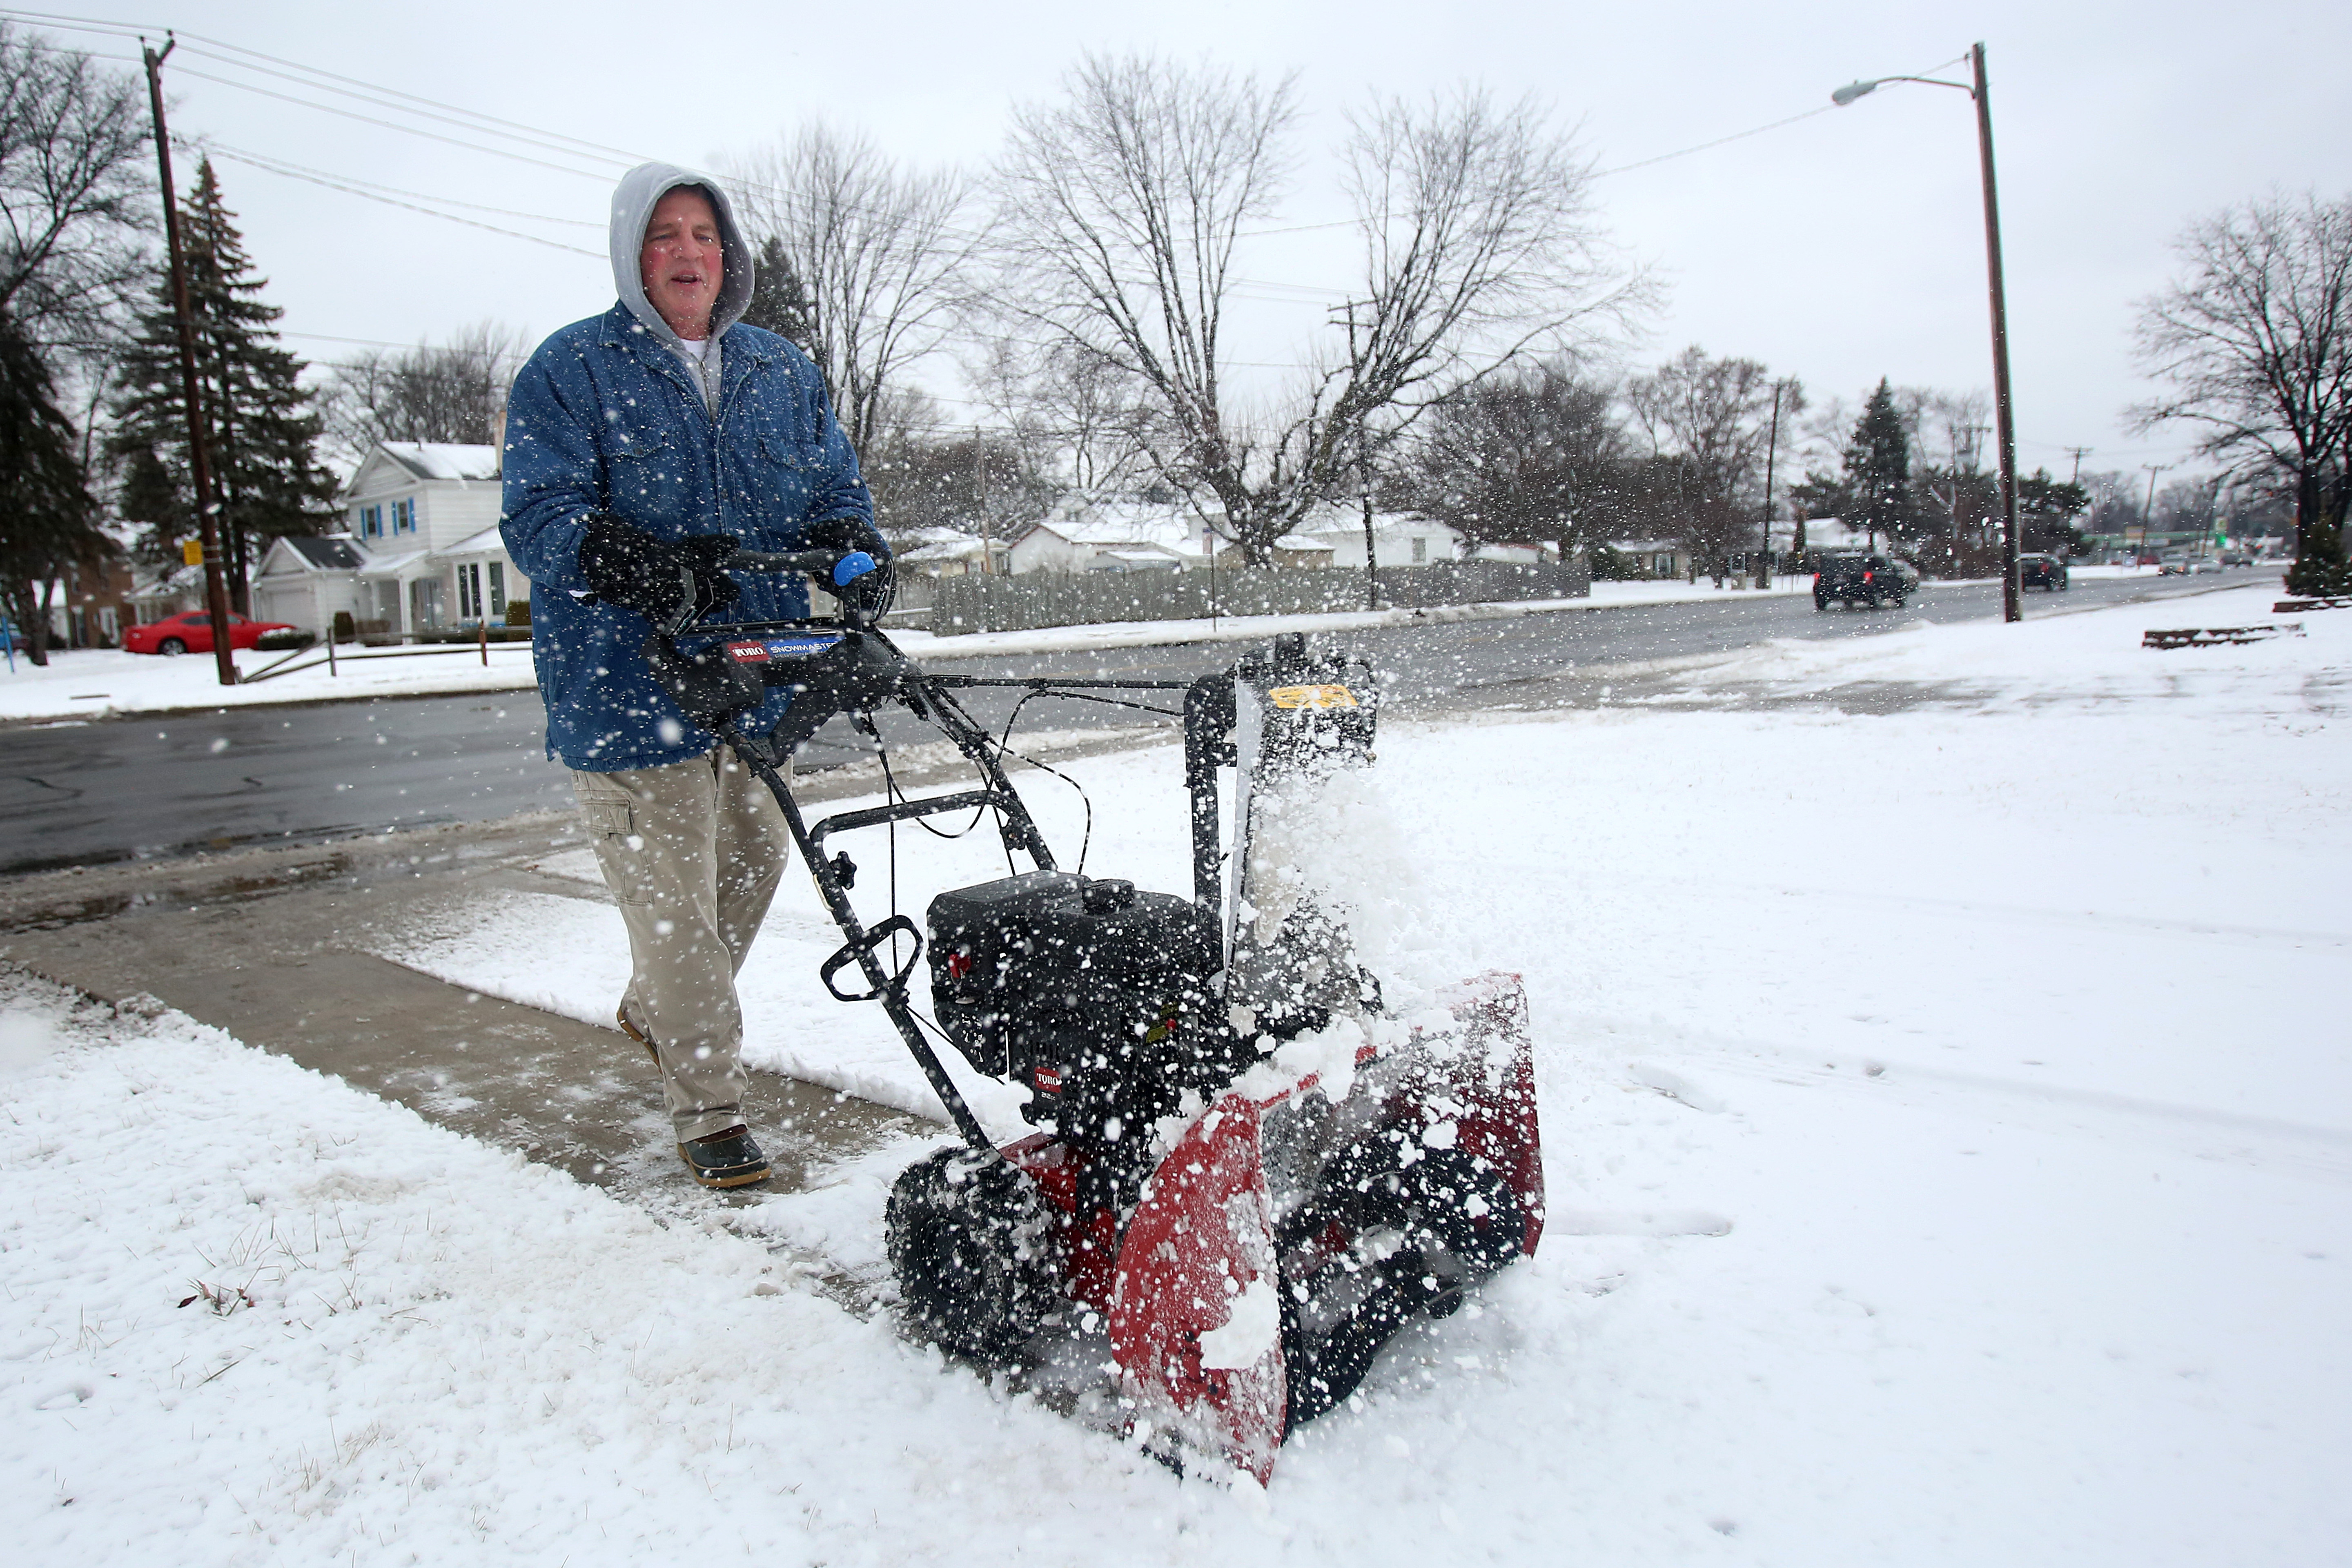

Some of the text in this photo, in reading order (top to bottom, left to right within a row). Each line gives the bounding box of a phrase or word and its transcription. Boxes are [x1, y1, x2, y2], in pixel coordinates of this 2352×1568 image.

[732, 647, 764, 657] TORO
[1036, 1073, 1058, 1086] TORO
[1041, 1091, 1056, 1101] 212cc
